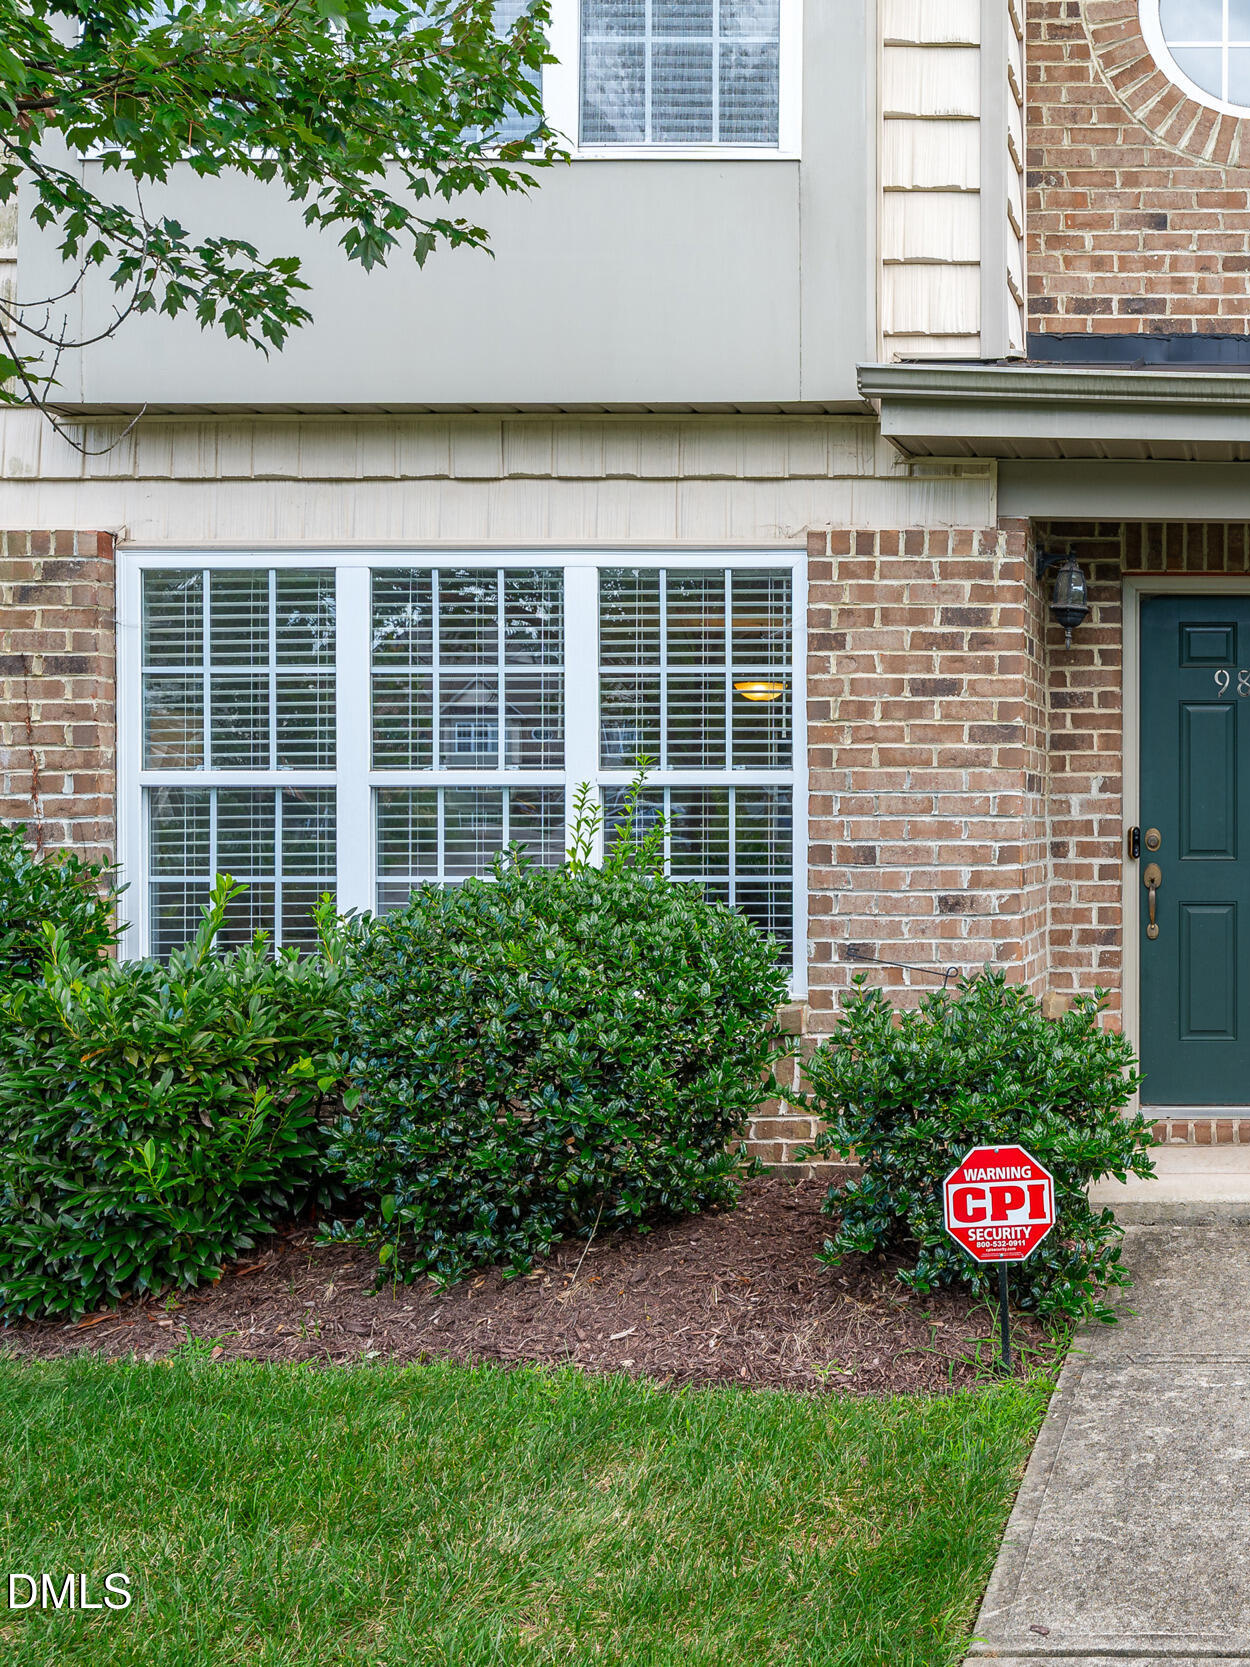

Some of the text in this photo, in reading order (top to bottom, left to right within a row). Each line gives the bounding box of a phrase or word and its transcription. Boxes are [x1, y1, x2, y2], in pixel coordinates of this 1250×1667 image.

[963, 1165, 1032, 1181] WARNING
[952, 1184, 1047, 1223] CPI
[968, 1226, 1032, 1241] SECURITY
[976, 1240, 1026, 1248] 800-532-0911
